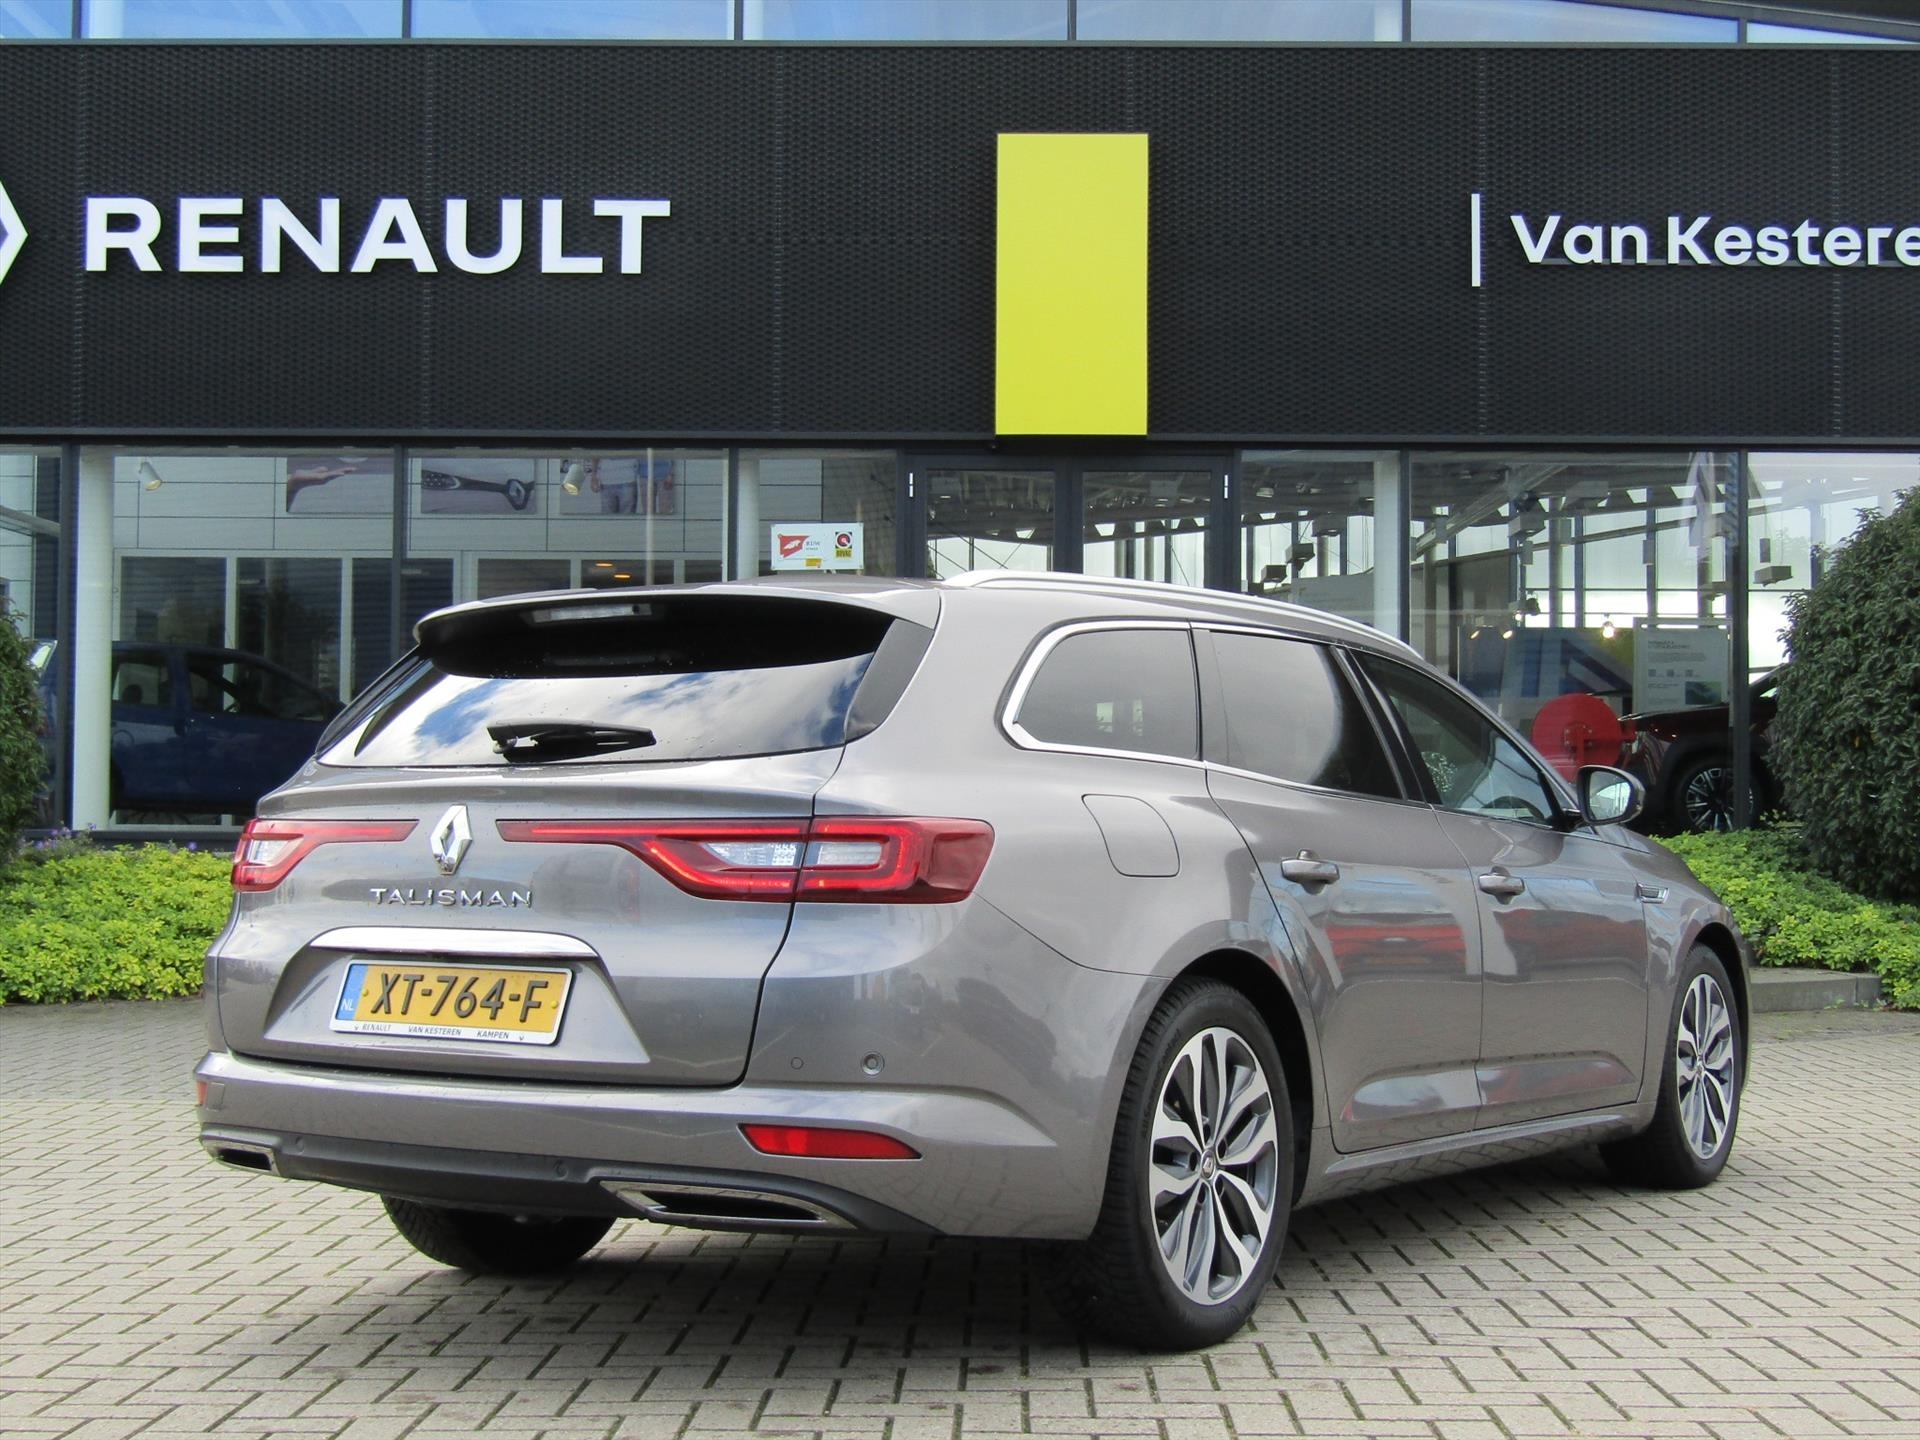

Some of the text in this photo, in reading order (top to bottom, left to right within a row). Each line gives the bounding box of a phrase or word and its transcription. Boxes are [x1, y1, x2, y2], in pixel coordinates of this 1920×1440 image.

[85, 197, 671, 275] RENAULT
[1510, 215, 1920, 267] Van Kestere
[370, 887, 533, 909] TALISMAN
[341, 998, 354, 1011] NL
[371, 972, 549, 1023] XT-764-F
[362, 1023, 510, 1040] RENAULT VAN KESTEREN KAMPEN
